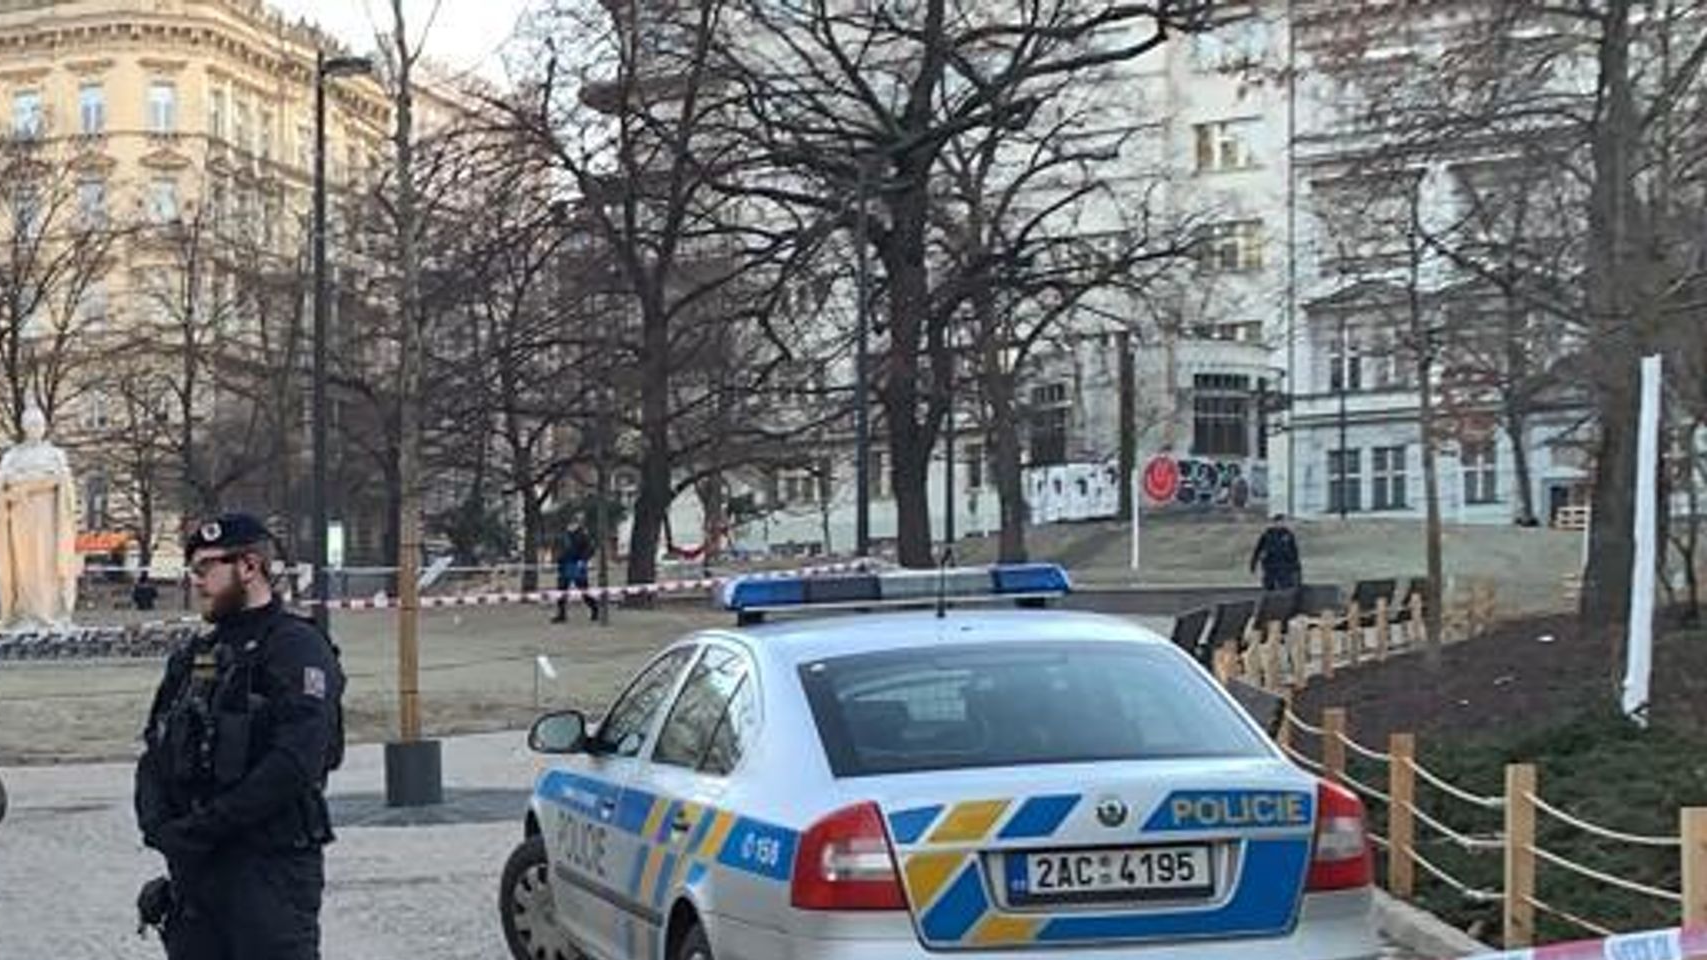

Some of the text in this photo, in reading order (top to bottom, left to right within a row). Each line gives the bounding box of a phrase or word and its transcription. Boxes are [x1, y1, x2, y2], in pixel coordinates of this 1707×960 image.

[1172, 793, 1306, 826] POLICIE
[1036, 856, 1094, 889] 2AC
[1119, 852, 1196, 885] 4195
